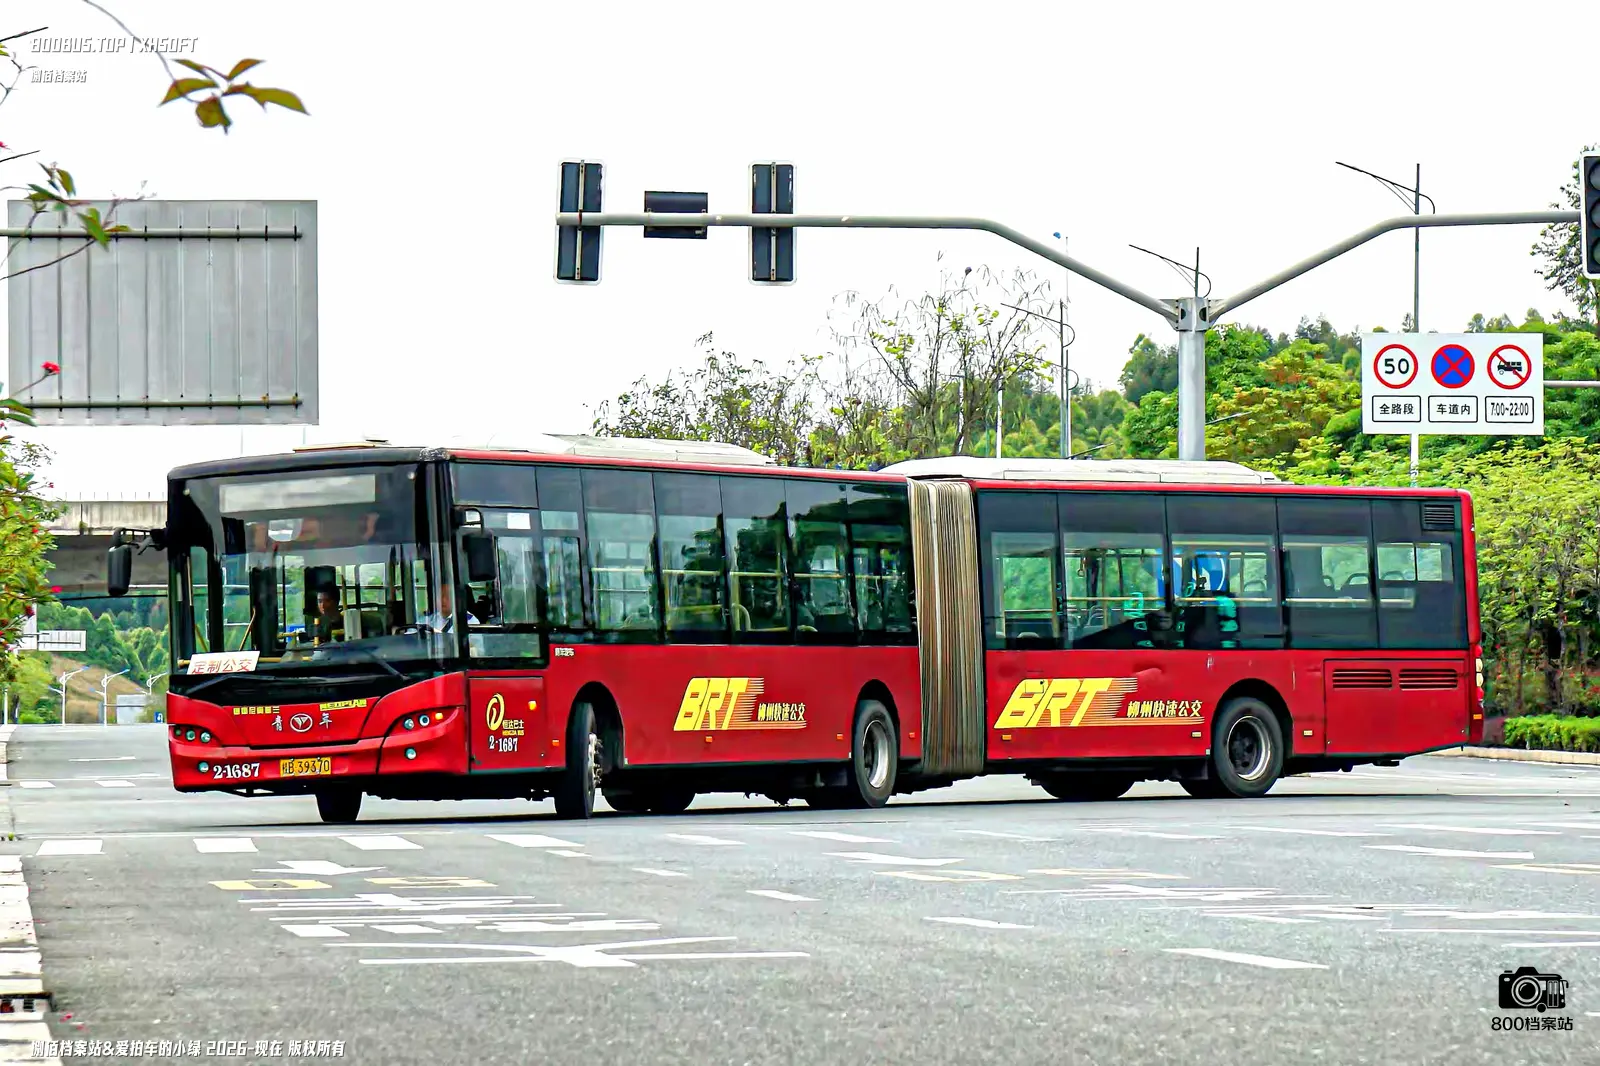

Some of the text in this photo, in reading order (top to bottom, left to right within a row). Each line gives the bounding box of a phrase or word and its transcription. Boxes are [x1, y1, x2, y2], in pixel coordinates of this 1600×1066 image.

[1384, 358, 1410, 374] 50
[1379, 403, 1414, 415] 全路段
[1436, 403, 1471, 415] 车道内
[192, 658, 253, 674] 定制公交
[673, 677, 806, 731] BRT 柳州快速公交
[994, 677, 1203, 729] BRT 柳州快速公交
[213, 763, 260, 779] 2-1687
